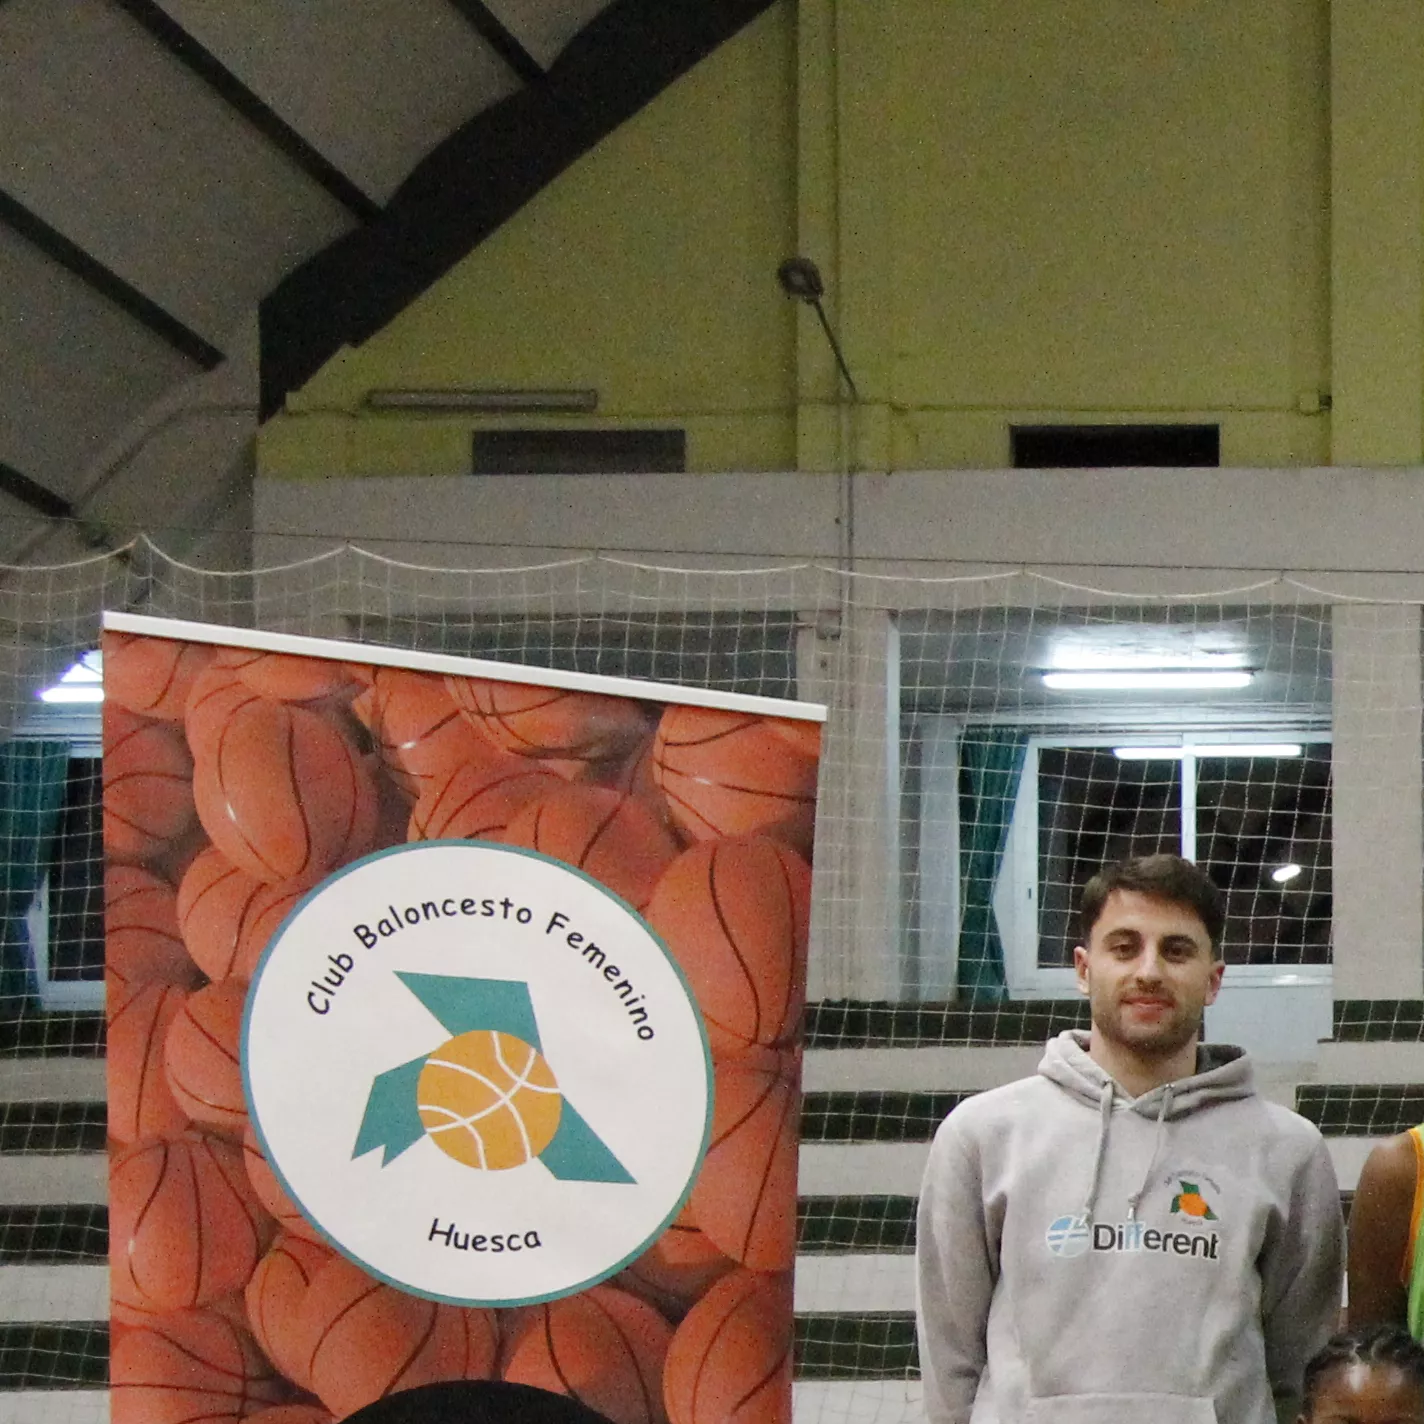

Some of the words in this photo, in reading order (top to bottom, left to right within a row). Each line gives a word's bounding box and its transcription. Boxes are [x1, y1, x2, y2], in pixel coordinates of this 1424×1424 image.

[308, 952, 354, 1016] Club
[354, 897, 532, 949] Baloncesto
[546, 913, 654, 1042] Femenino
[428, 1218, 541, 1253] Huesca
[1093, 1221, 1219, 1259] Different
